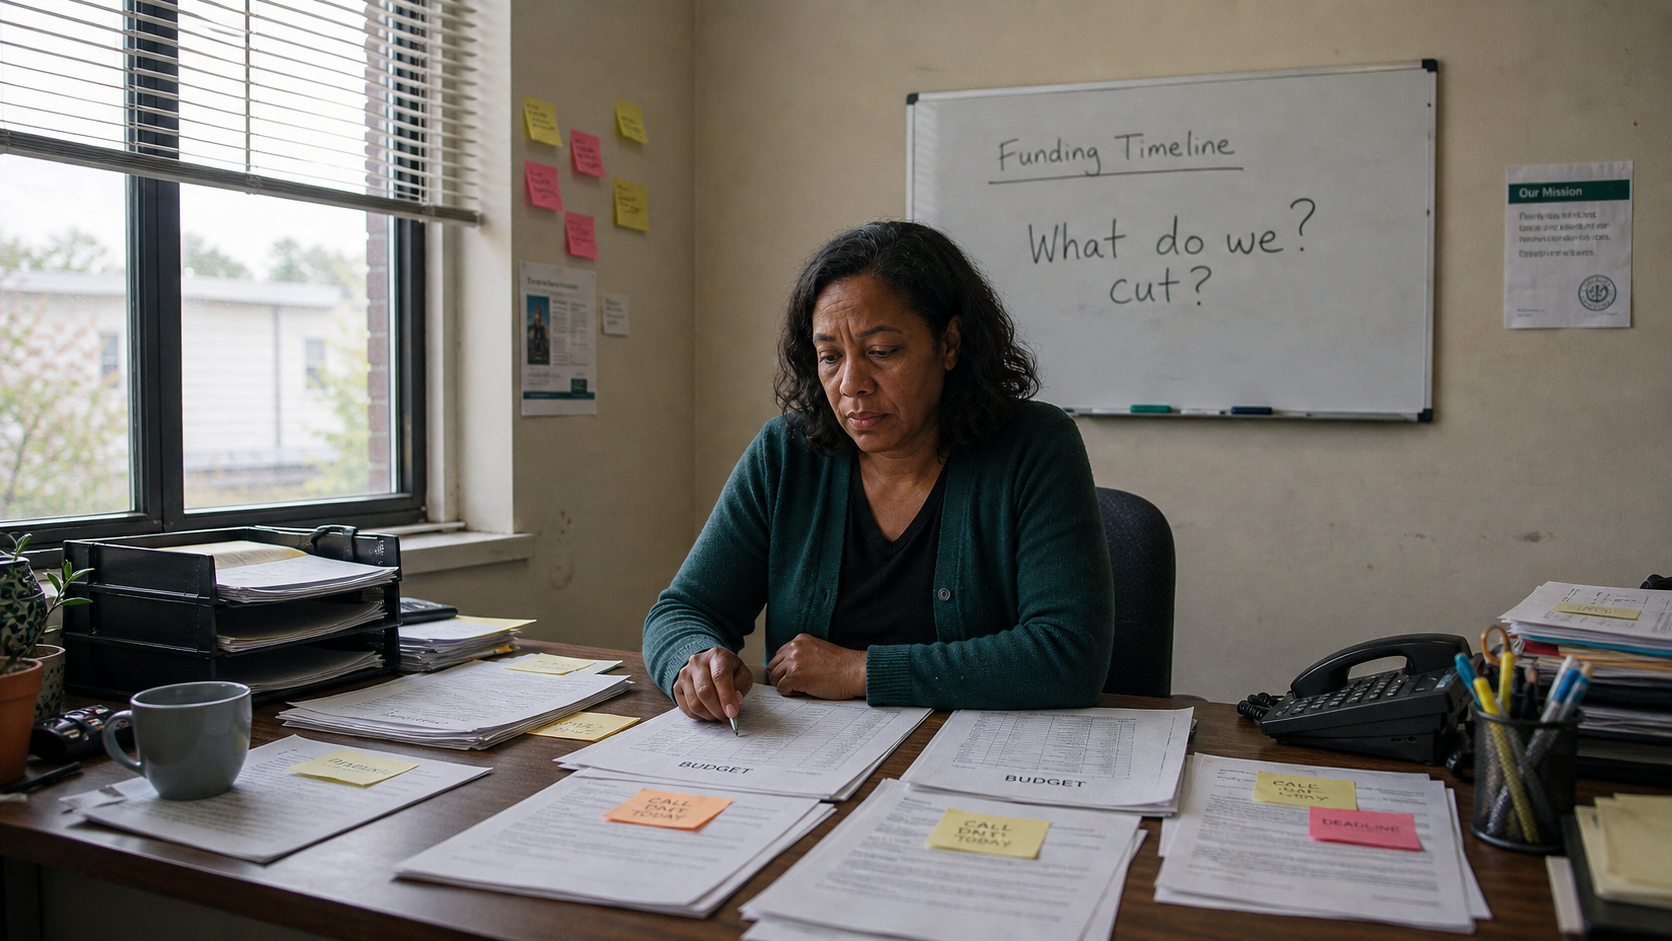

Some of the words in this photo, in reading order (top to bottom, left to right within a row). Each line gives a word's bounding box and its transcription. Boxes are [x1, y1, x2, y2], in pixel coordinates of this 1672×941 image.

[999, 138, 1101, 176] Funding
[1114, 130, 1236, 160] Timeline
[1519, 187, 1539, 198] Our
[1542, 186, 1583, 198] Mission
[1028, 218, 1127, 264] What
[1156, 215, 1204, 256] do
[1109, 265, 1212, 306] cut?
[679, 761, 755, 774] BUDGET
[1005, 774, 1087, 787] BUDGET
[648, 797, 691, 807] CALL
[631, 809, 686, 821] TODAY
[964, 820, 1012, 831] CALL
[1322, 818, 1400, 832] DEADLINE
[953, 834, 1012, 848] TODAY
